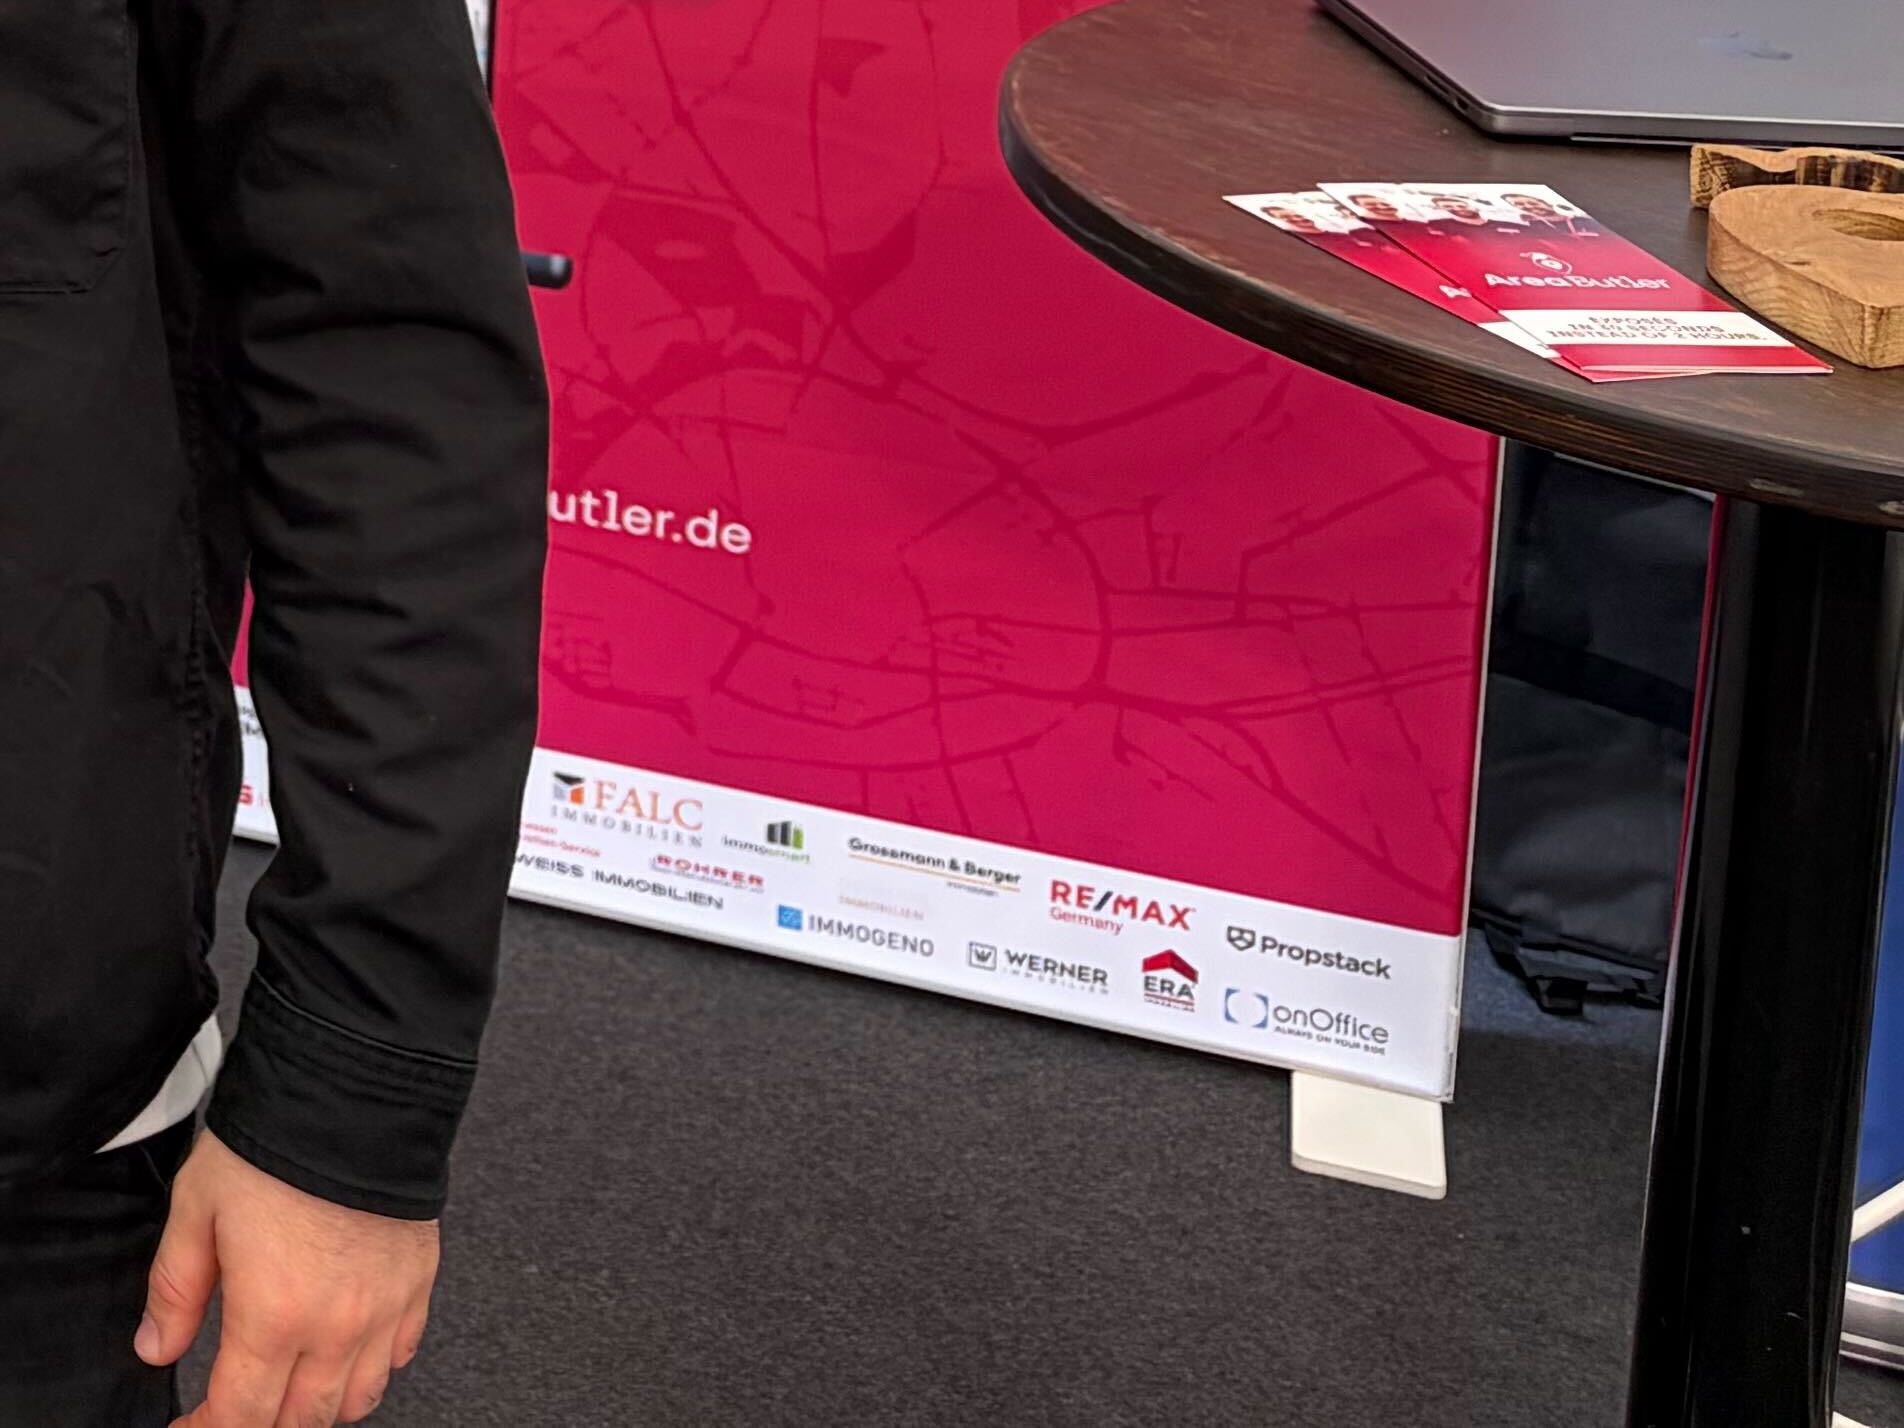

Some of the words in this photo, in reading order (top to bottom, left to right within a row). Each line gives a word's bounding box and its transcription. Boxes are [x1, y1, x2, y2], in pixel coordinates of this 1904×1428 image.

[1484, 273, 1672, 290] AreaButler
[550, 804, 704, 849] IMMOBILIEN
[593, 779, 704, 831] FALC
[848, 836, 945, 870] Grossmann
[948, 858, 961, 871] &
[964, 860, 1021, 886] Berger
[593, 868, 724, 910] IMMOBILIEN
[1049, 879, 1191, 931] RE/MAX
[808, 914, 935, 958] IMMOGENO
[1049, 907, 1124, 936] Germany
[1004, 949, 1109, 986] WERNER
[1260, 935, 1391, 980] Propstack
[1143, 975, 1195, 1001] ERA
[1272, 1005, 1390, 1044] onOffice
